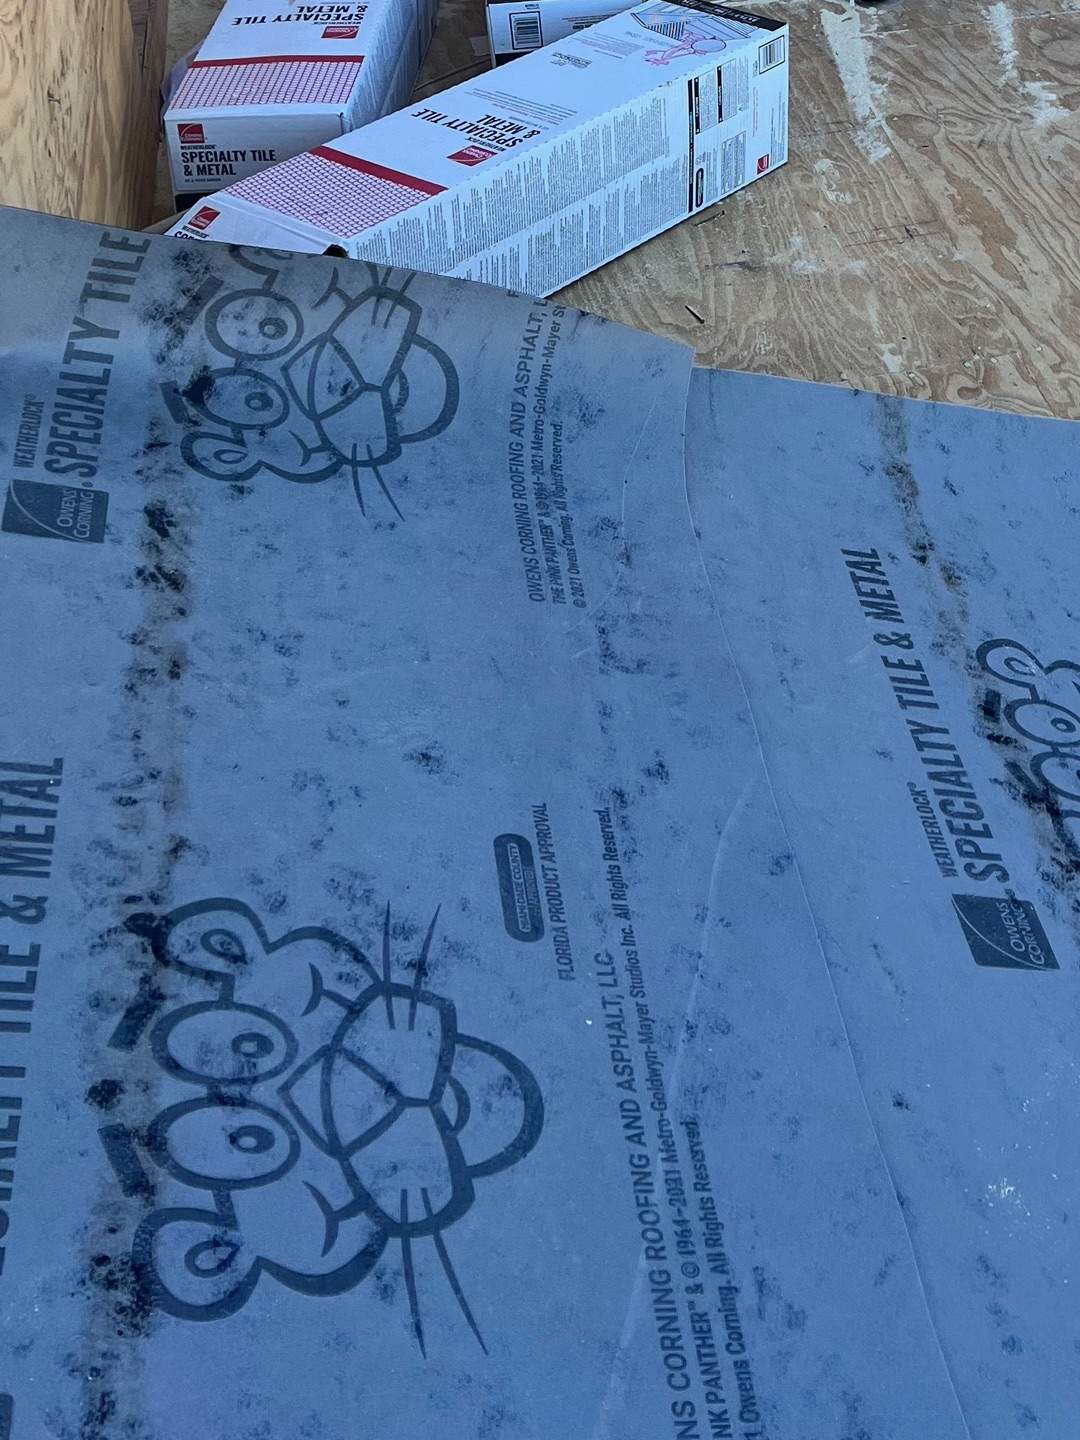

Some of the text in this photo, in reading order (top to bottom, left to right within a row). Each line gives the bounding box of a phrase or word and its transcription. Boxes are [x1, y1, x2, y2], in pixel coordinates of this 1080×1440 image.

[232, 13, 364, 26] SPECIALTY TILE
[296, 5, 368, 13] & METAL
[411, 109, 523, 148] SPECIALTY TILE
[477, 114, 540, 139] & METAL
[181, 149, 277, 164] SPECIALTY TILE
[184, 163, 236, 177] & METAL
[43, 232, 151, 478] SPECIALTY TILE
[511, 311, 549, 399] ASPHALT,
[531, 321, 563, 452] Metro-Goldwyn-Mayer
[510, 402, 527, 439] AND
[507, 441, 528, 500] ROOFING
[550, 473, 568, 500] Rights
[56, 488, 78, 528] OWENS
[73, 490, 96, 539] CORNING
[513, 503, 538, 555] CORNING
[523, 557, 547, 602] OWENS
[547, 569, 564, 587] PINK
[566, 547, 580, 575] Owens
[551, 588, 567, 605] THE
[570, 577, 584, 598] 2021
[840, 548, 1010, 884] SPECIALTY TILE & METAL
[0, 757, 64, 925] & METAL
[594, 806, 621, 862] Reserved.
[532, 802, 577, 981] FLORIDA PRODUCT APPROVAL
[606, 864, 629, 902] Rights
[611, 904, 631, 921] All
[995, 902, 1026, 953] OWENS
[620, 923, 635, 948] Inc.
[593, 952, 619, 989] LLC
[623, 949, 647, 999] Studios
[601, 994, 637, 1094] ASPHALT,
[633, 1002, 679, 1164] Metro-Goldwyn-Mayer
[619, 1099, 647, 1149] AND
[628, 1154, 668, 1261] ROOFING
[698, 1195, 725, 1250] Rights
[681, 1261, 701, 1280] ©
[706, 1252, 730, 1276] All
[685, 1282, 704, 1295] &
[647, 1269, 690, 1392] CORNING
[732, 1360, 761, 1425] Owens
